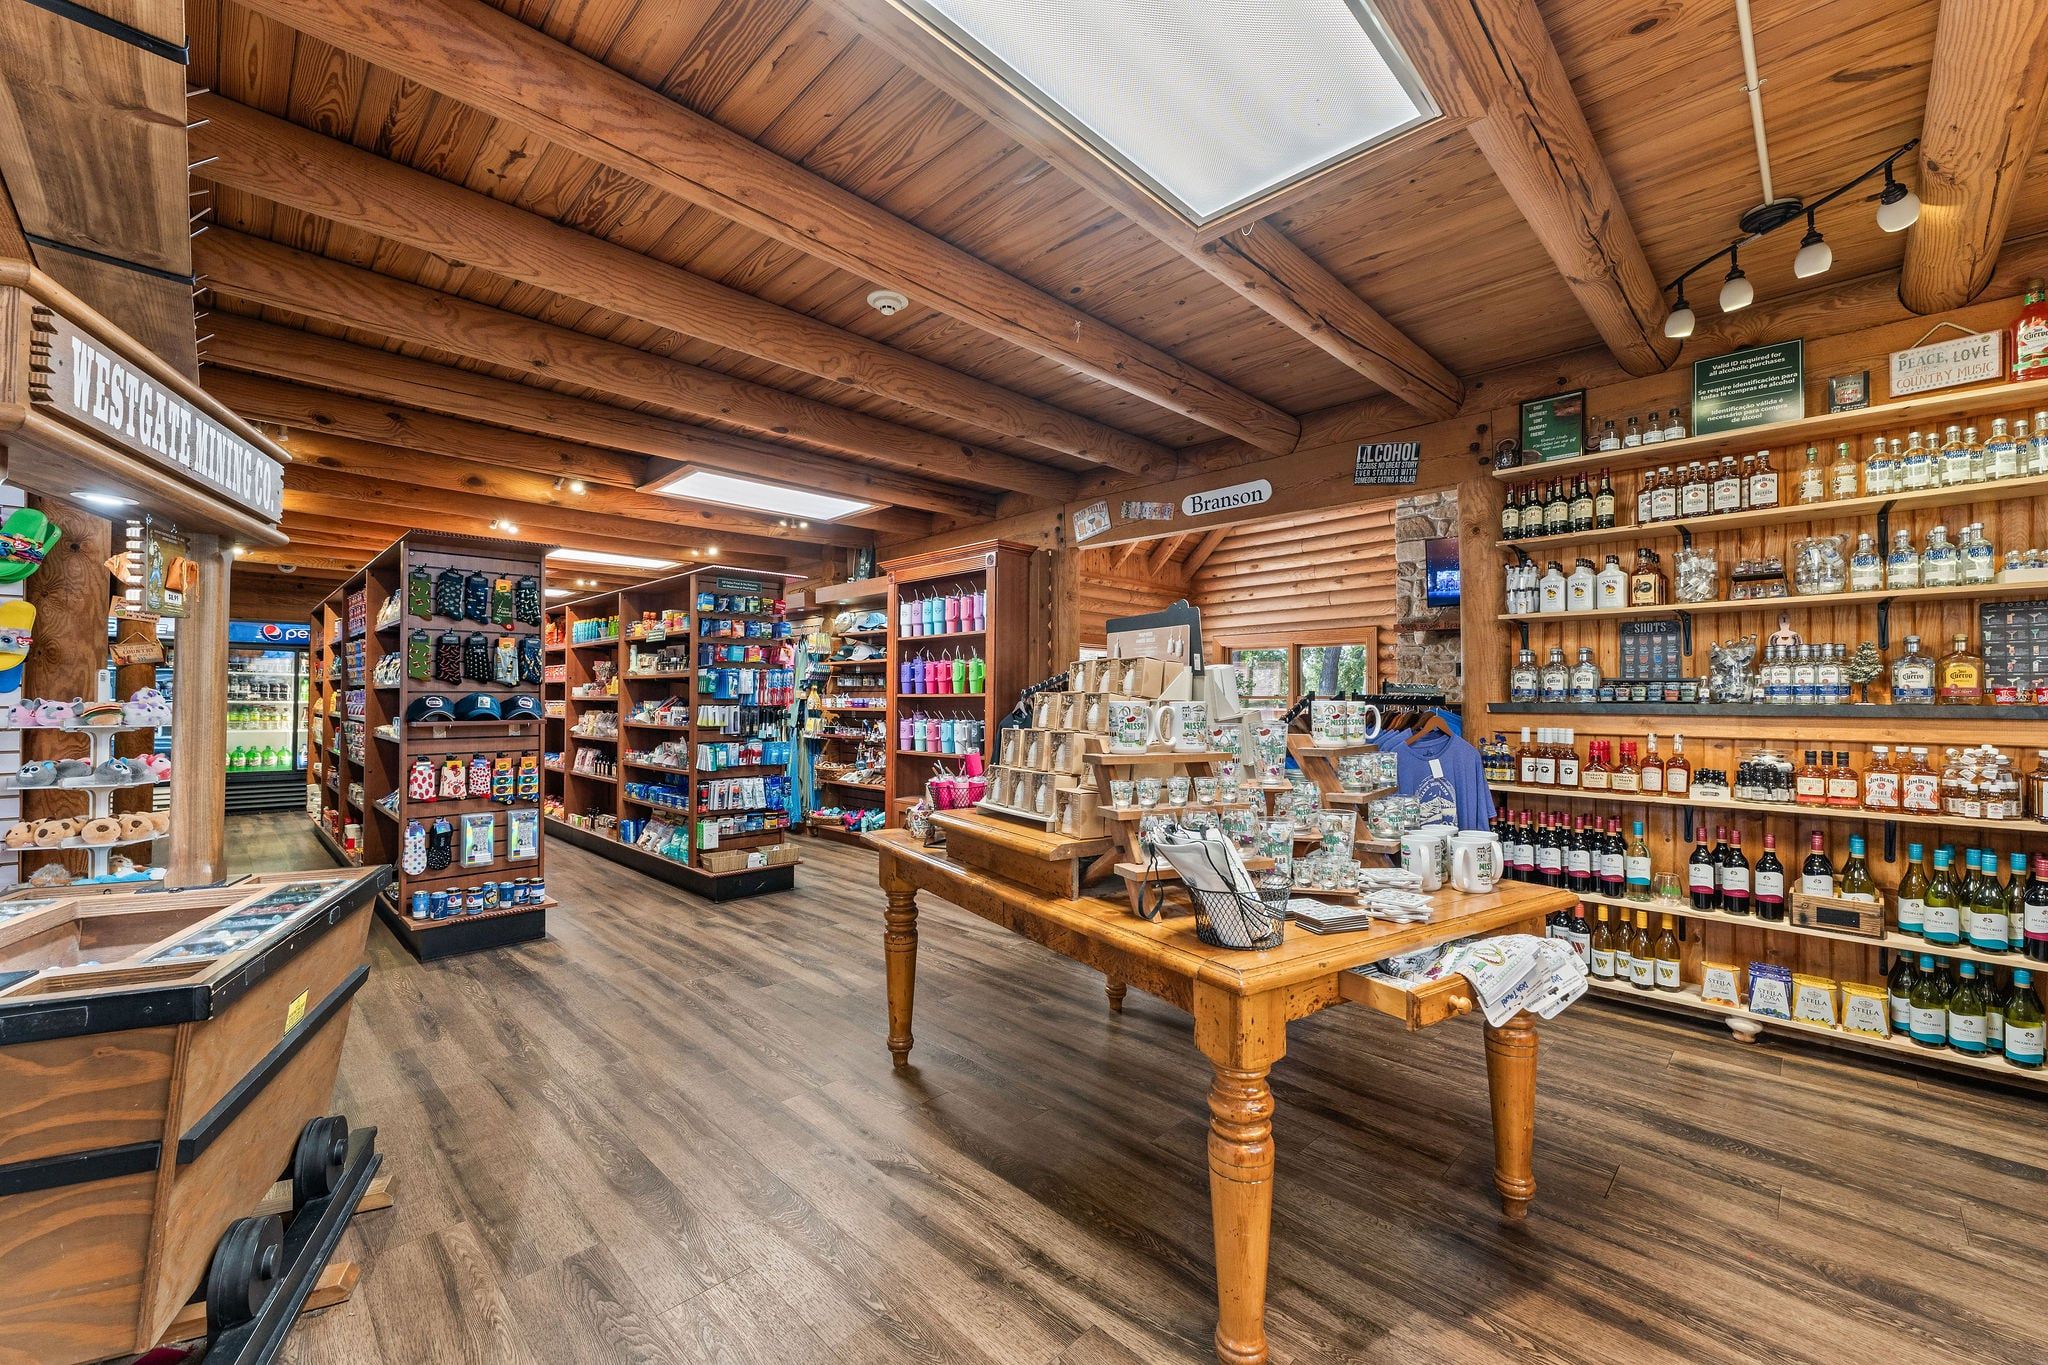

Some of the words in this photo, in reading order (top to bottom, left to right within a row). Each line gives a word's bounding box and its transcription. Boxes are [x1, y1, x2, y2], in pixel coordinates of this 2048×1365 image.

[1953, 344, 1990, 363] LOVE
[1709, 369, 1718, 377] all
[1718, 363, 1748, 375] alcoholic
[1749, 357, 1785, 370] purchases
[1712, 361, 1729, 370] Valid
[1739, 354, 1770, 366] required
[1896, 370, 1953, 390] COUNTRY
[1957, 361, 1994, 379] MUSIC
[1707, 383, 1732, 395] require
[1781, 372, 1798, 382] para
[1700, 393, 1719, 401] todas
[1728, 386, 1757, 397] compras
[1768, 378, 1795, 388] alcohol
[71, 335, 192, 468] WESTGATE
[194, 417, 252, 496] MINING
[1743, 408, 1760, 418] para
[1760, 403, 1788, 415] compra
[1356, 462, 1378, 470] BECAUSE
[1386, 461, 1401, 469] GREAT
[1401, 460, 1418, 469] STORY
[1355, 469, 1371, 477] EVER
[1372, 469, 1399, 477] STARTED
[1401, 468, 1417, 476] WITH
[1354, 476, 1377, 484] SOMEONE
[1399, 475, 1416, 483] SALAD
[1191, 488, 1264, 514] Branson
[1634, 622, 1667, 633] SHOTS
[285, 628, 310, 641] pe
[1902, 672, 1924, 680] Cuervo
[1950, 671, 1973, 680] Cuervo
[1879, 777, 1895, 786] BEAM
[1906, 779, 1917, 787] JIM
[1918, 778, 1934, 787] BEAM
[1708, 977, 1732, 987] STELLA
[1757, 987, 1783, 998] STELLA
[1759, 993, 1781, 1002] ROSA
[1801, 996, 1827, 1006] STELLA
[1851, 1006, 1880, 1017] STELLA
